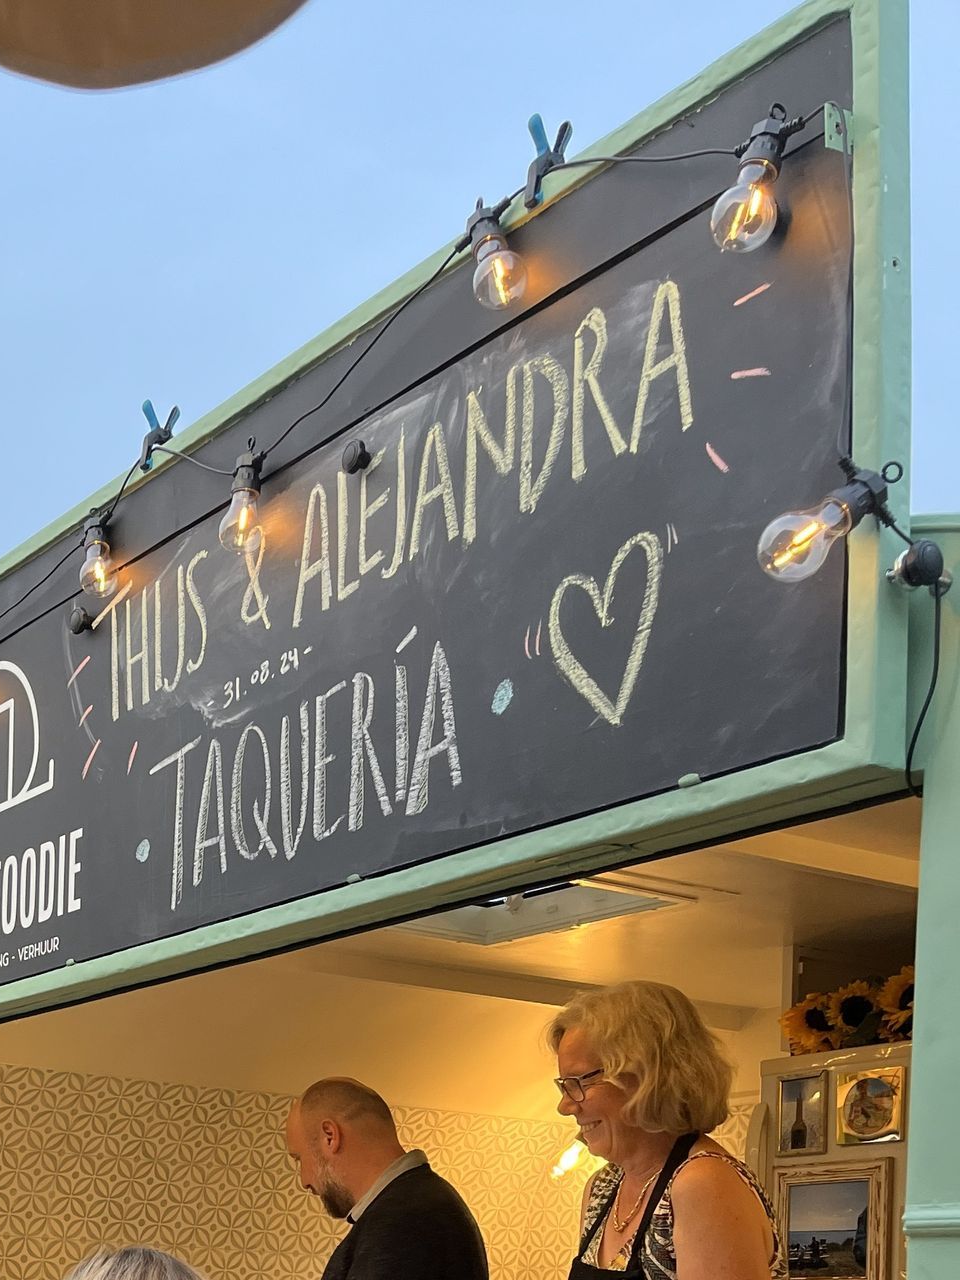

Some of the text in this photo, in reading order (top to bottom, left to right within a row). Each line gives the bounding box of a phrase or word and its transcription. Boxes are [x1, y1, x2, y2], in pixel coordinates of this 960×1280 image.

[93, 279, 693, 720] THIJS & ALEJANDRA
[149, 626, 464, 911] TAQUERÍA
[17, 936, 60, 962] VERHUUR
